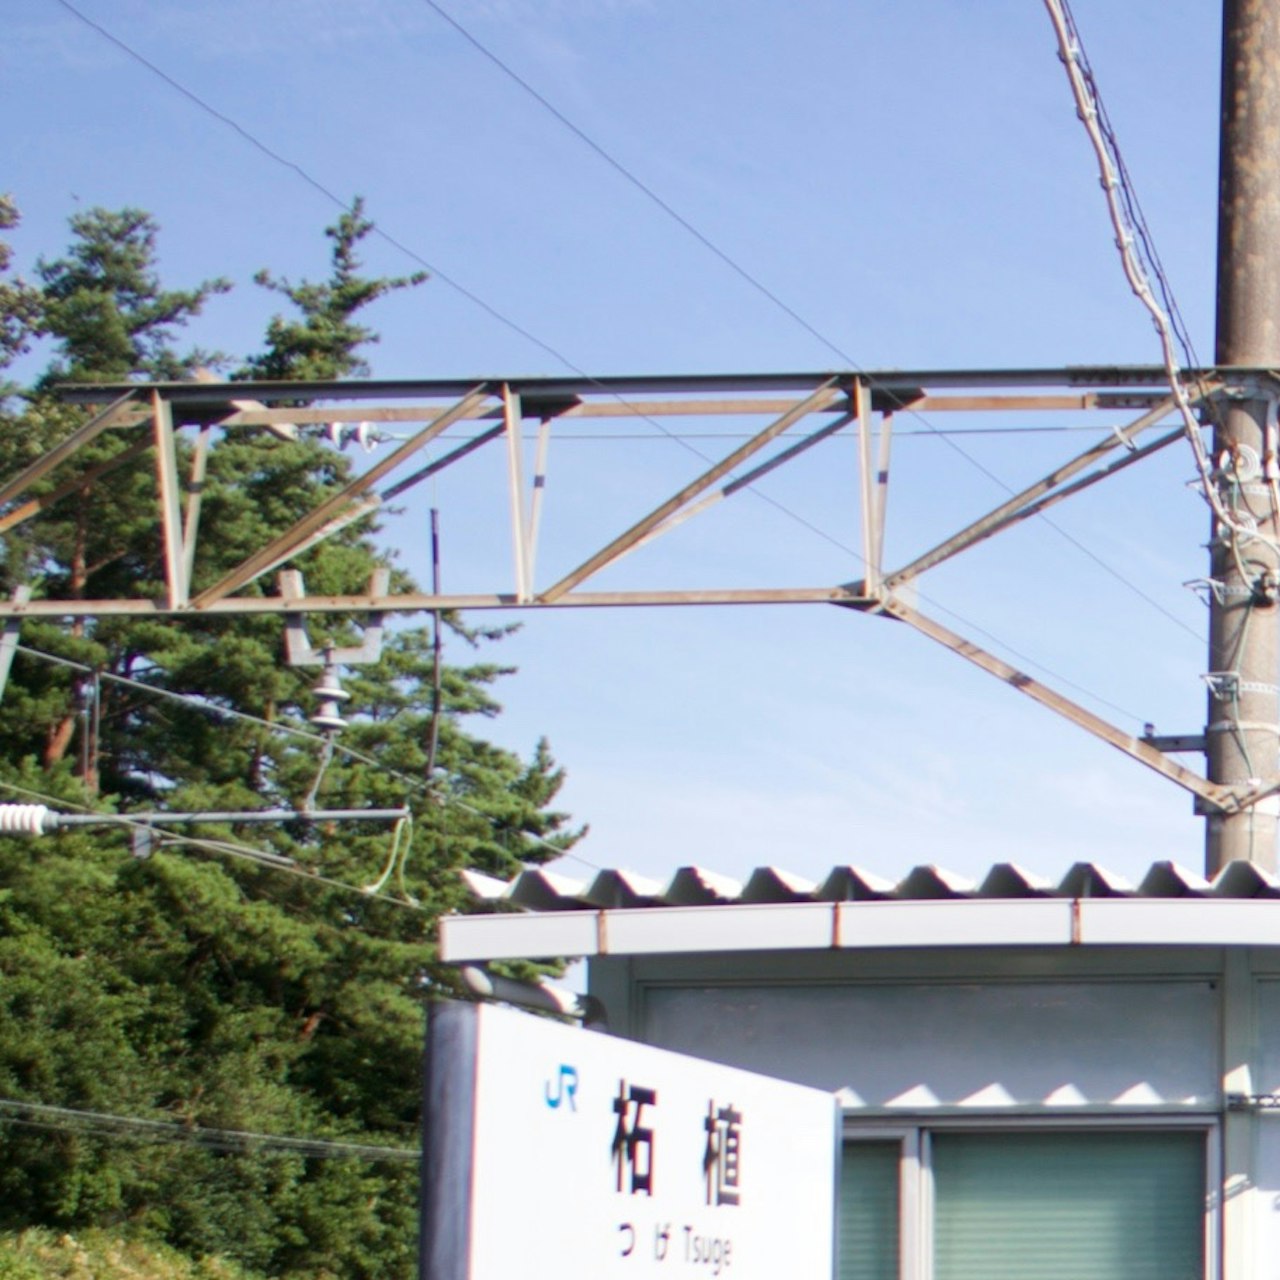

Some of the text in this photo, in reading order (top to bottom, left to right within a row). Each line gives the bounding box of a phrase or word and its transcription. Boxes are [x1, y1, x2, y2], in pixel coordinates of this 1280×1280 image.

[545, 1063, 578, 1112] JR
[611, 1078, 742, 1207] 柘植
[618, 1222, 733, 1277] つげ Tsuge
